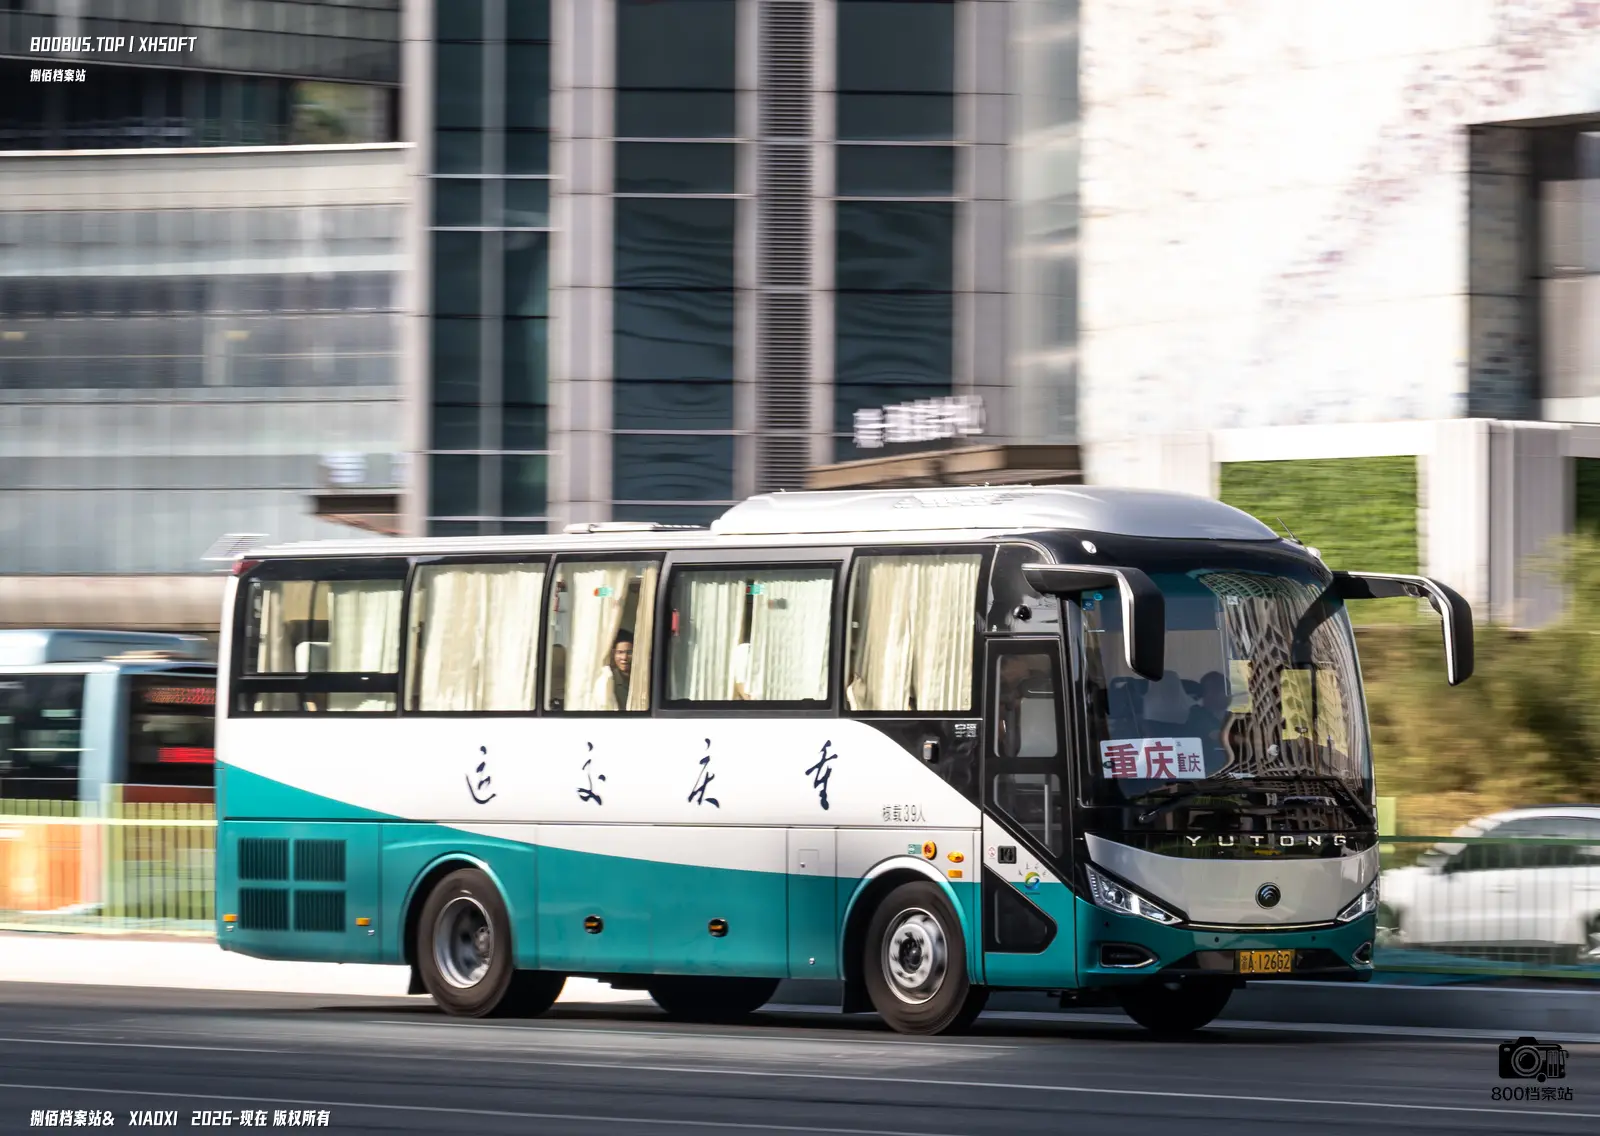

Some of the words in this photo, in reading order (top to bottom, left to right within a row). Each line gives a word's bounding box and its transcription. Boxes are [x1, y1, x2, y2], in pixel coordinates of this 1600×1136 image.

[1104, 741, 1177, 779] 重庆
[1177, 752, 1202, 773] 重庆
[1186, 835, 1347, 847] YUTONG
